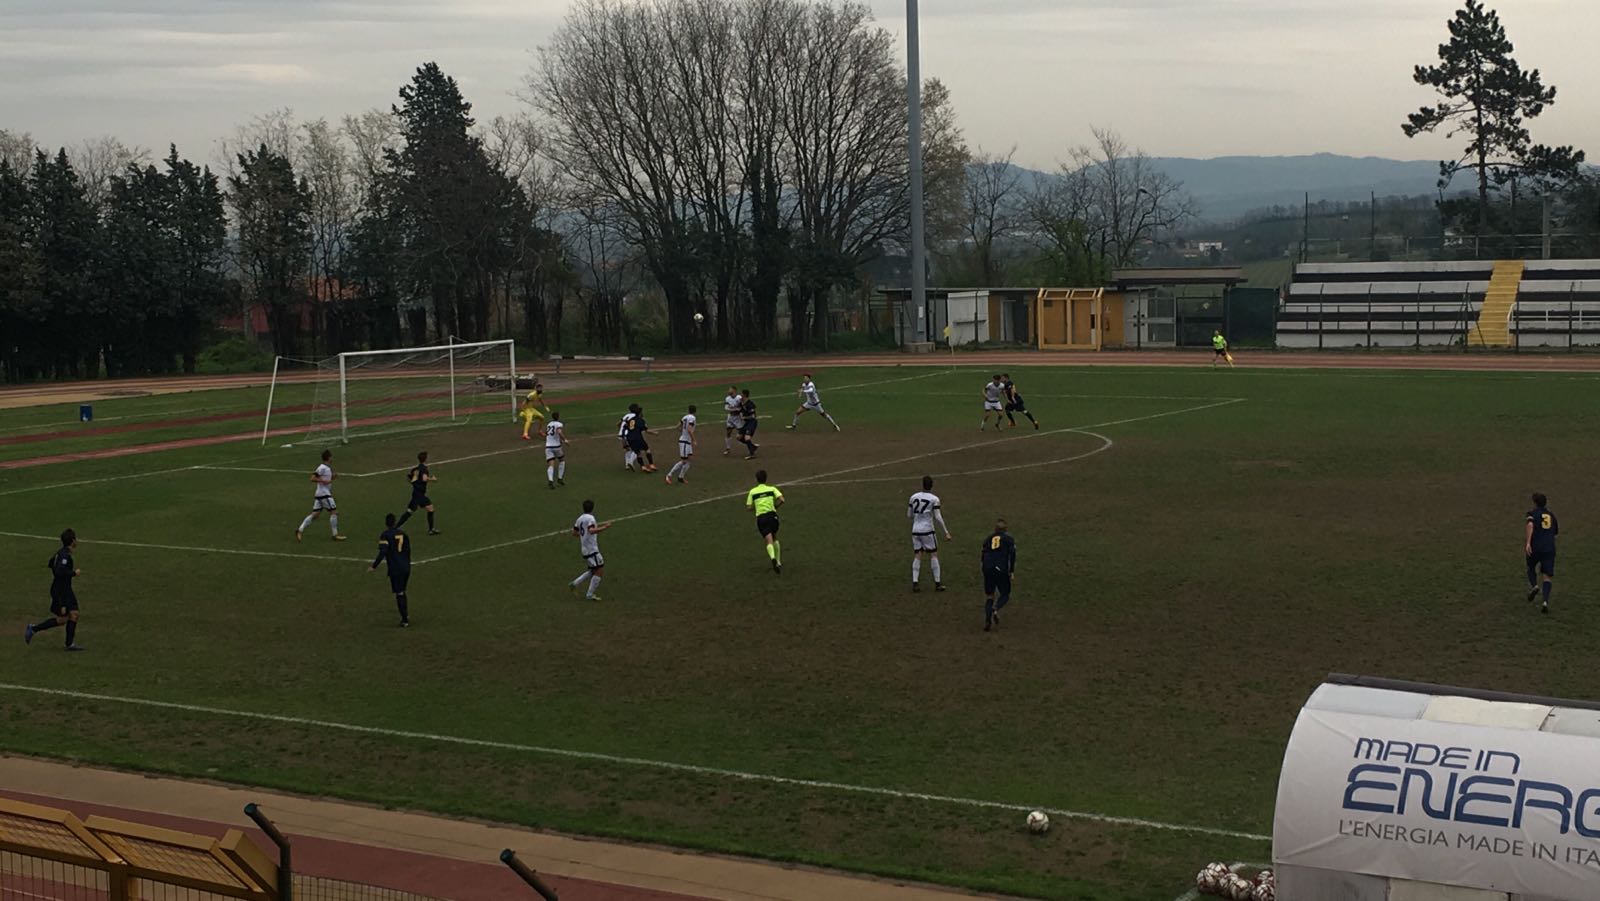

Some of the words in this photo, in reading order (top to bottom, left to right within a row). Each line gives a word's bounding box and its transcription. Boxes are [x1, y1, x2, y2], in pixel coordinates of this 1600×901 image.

[913, 499, 930, 514] 27
[1541, 514, 1552, 529] 3
[394, 535, 404, 552] 7
[1340, 819, 1448, 846] L'ENERGIA
[1457, 832, 1525, 857] MADE
[1532, 842, 1557, 860] IN
